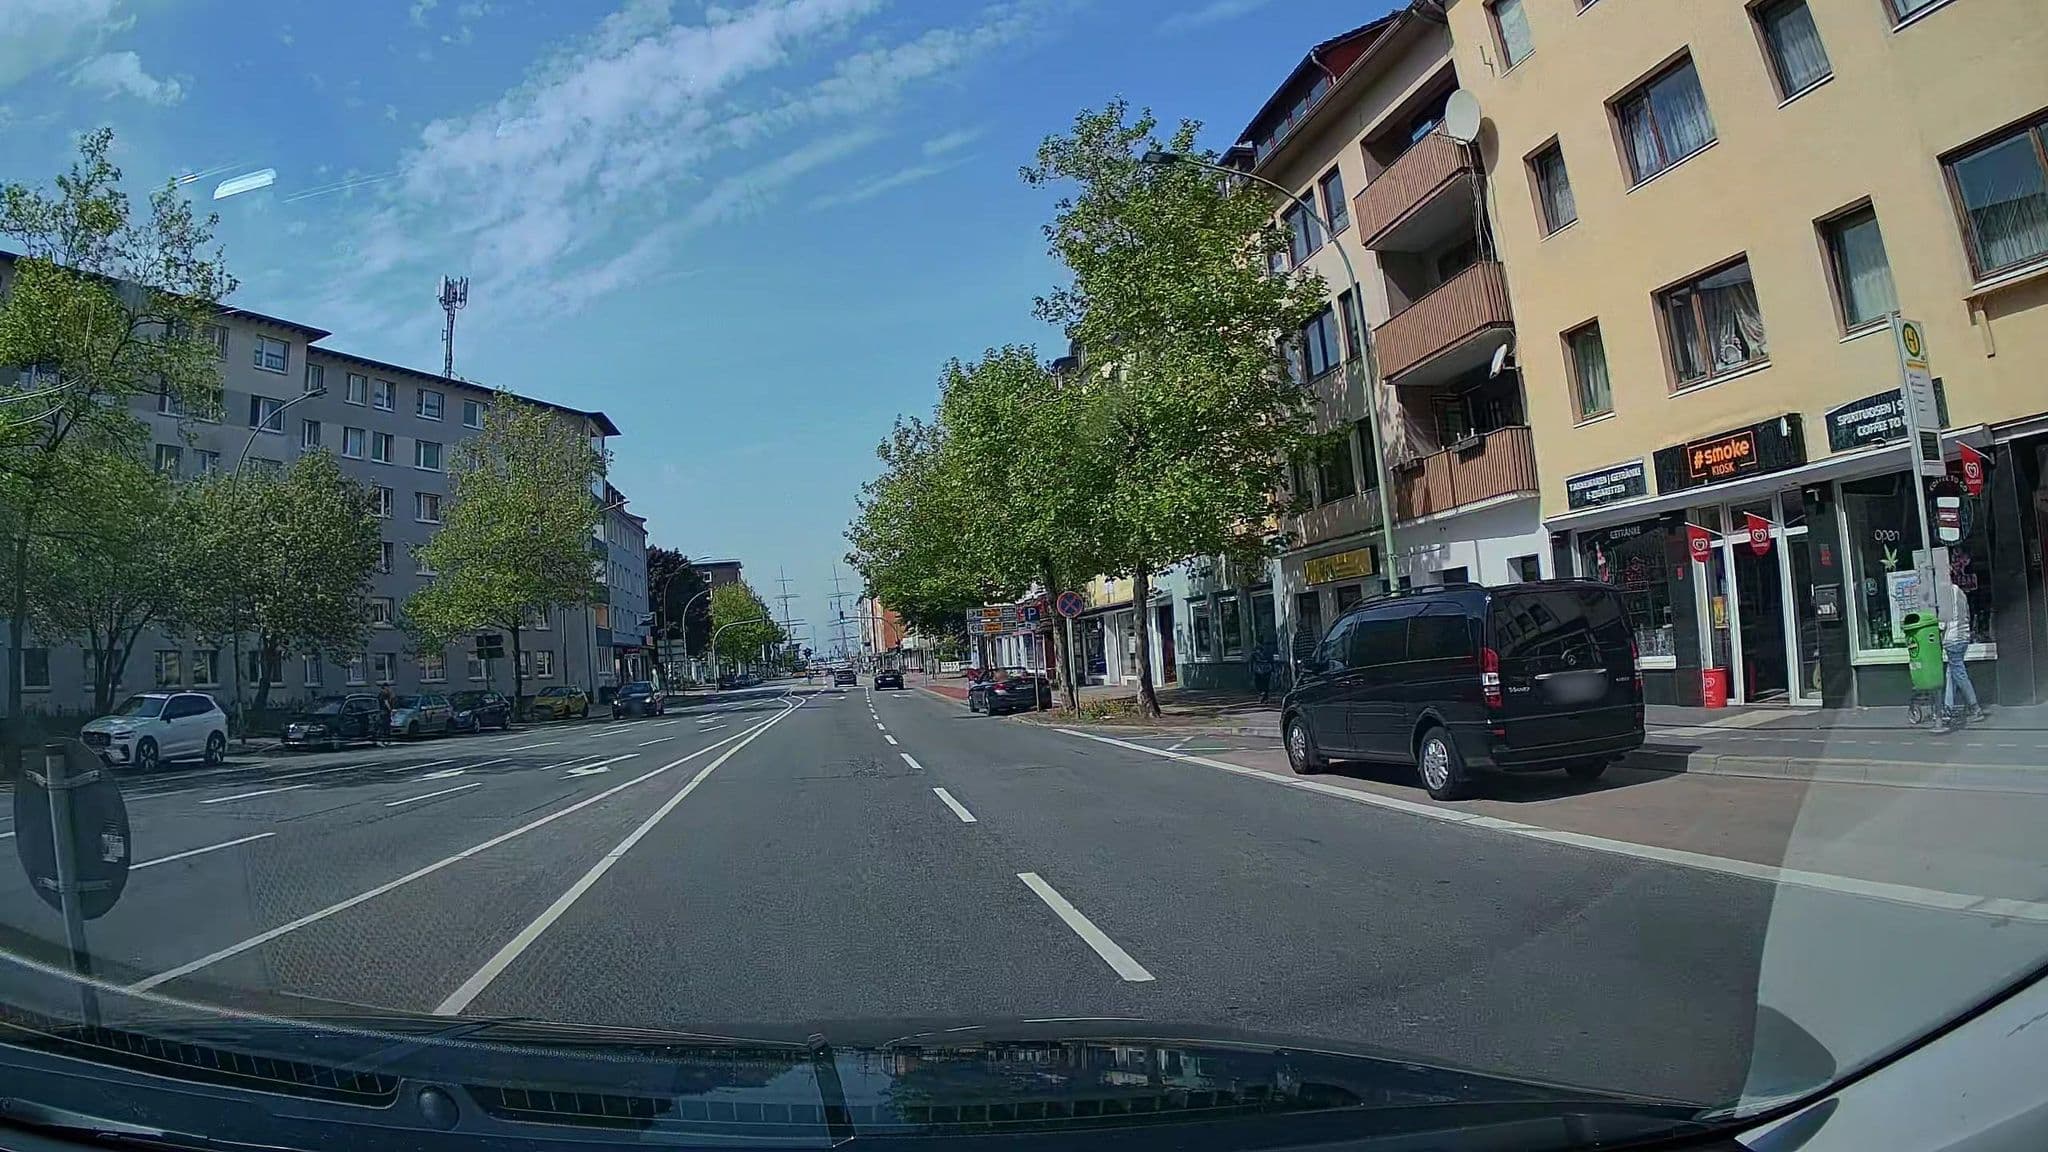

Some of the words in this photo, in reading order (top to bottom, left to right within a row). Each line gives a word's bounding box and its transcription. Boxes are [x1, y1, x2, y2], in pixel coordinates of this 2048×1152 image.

[1906, 330, 1917, 351] H
[1857, 420, 1889, 437] COFFEE
[1888, 416, 1901, 429] TO
[1694, 440, 1750, 469] #smoke
[1711, 462, 1734, 476] KIOSK
[1027, 607, 1037, 620] P
